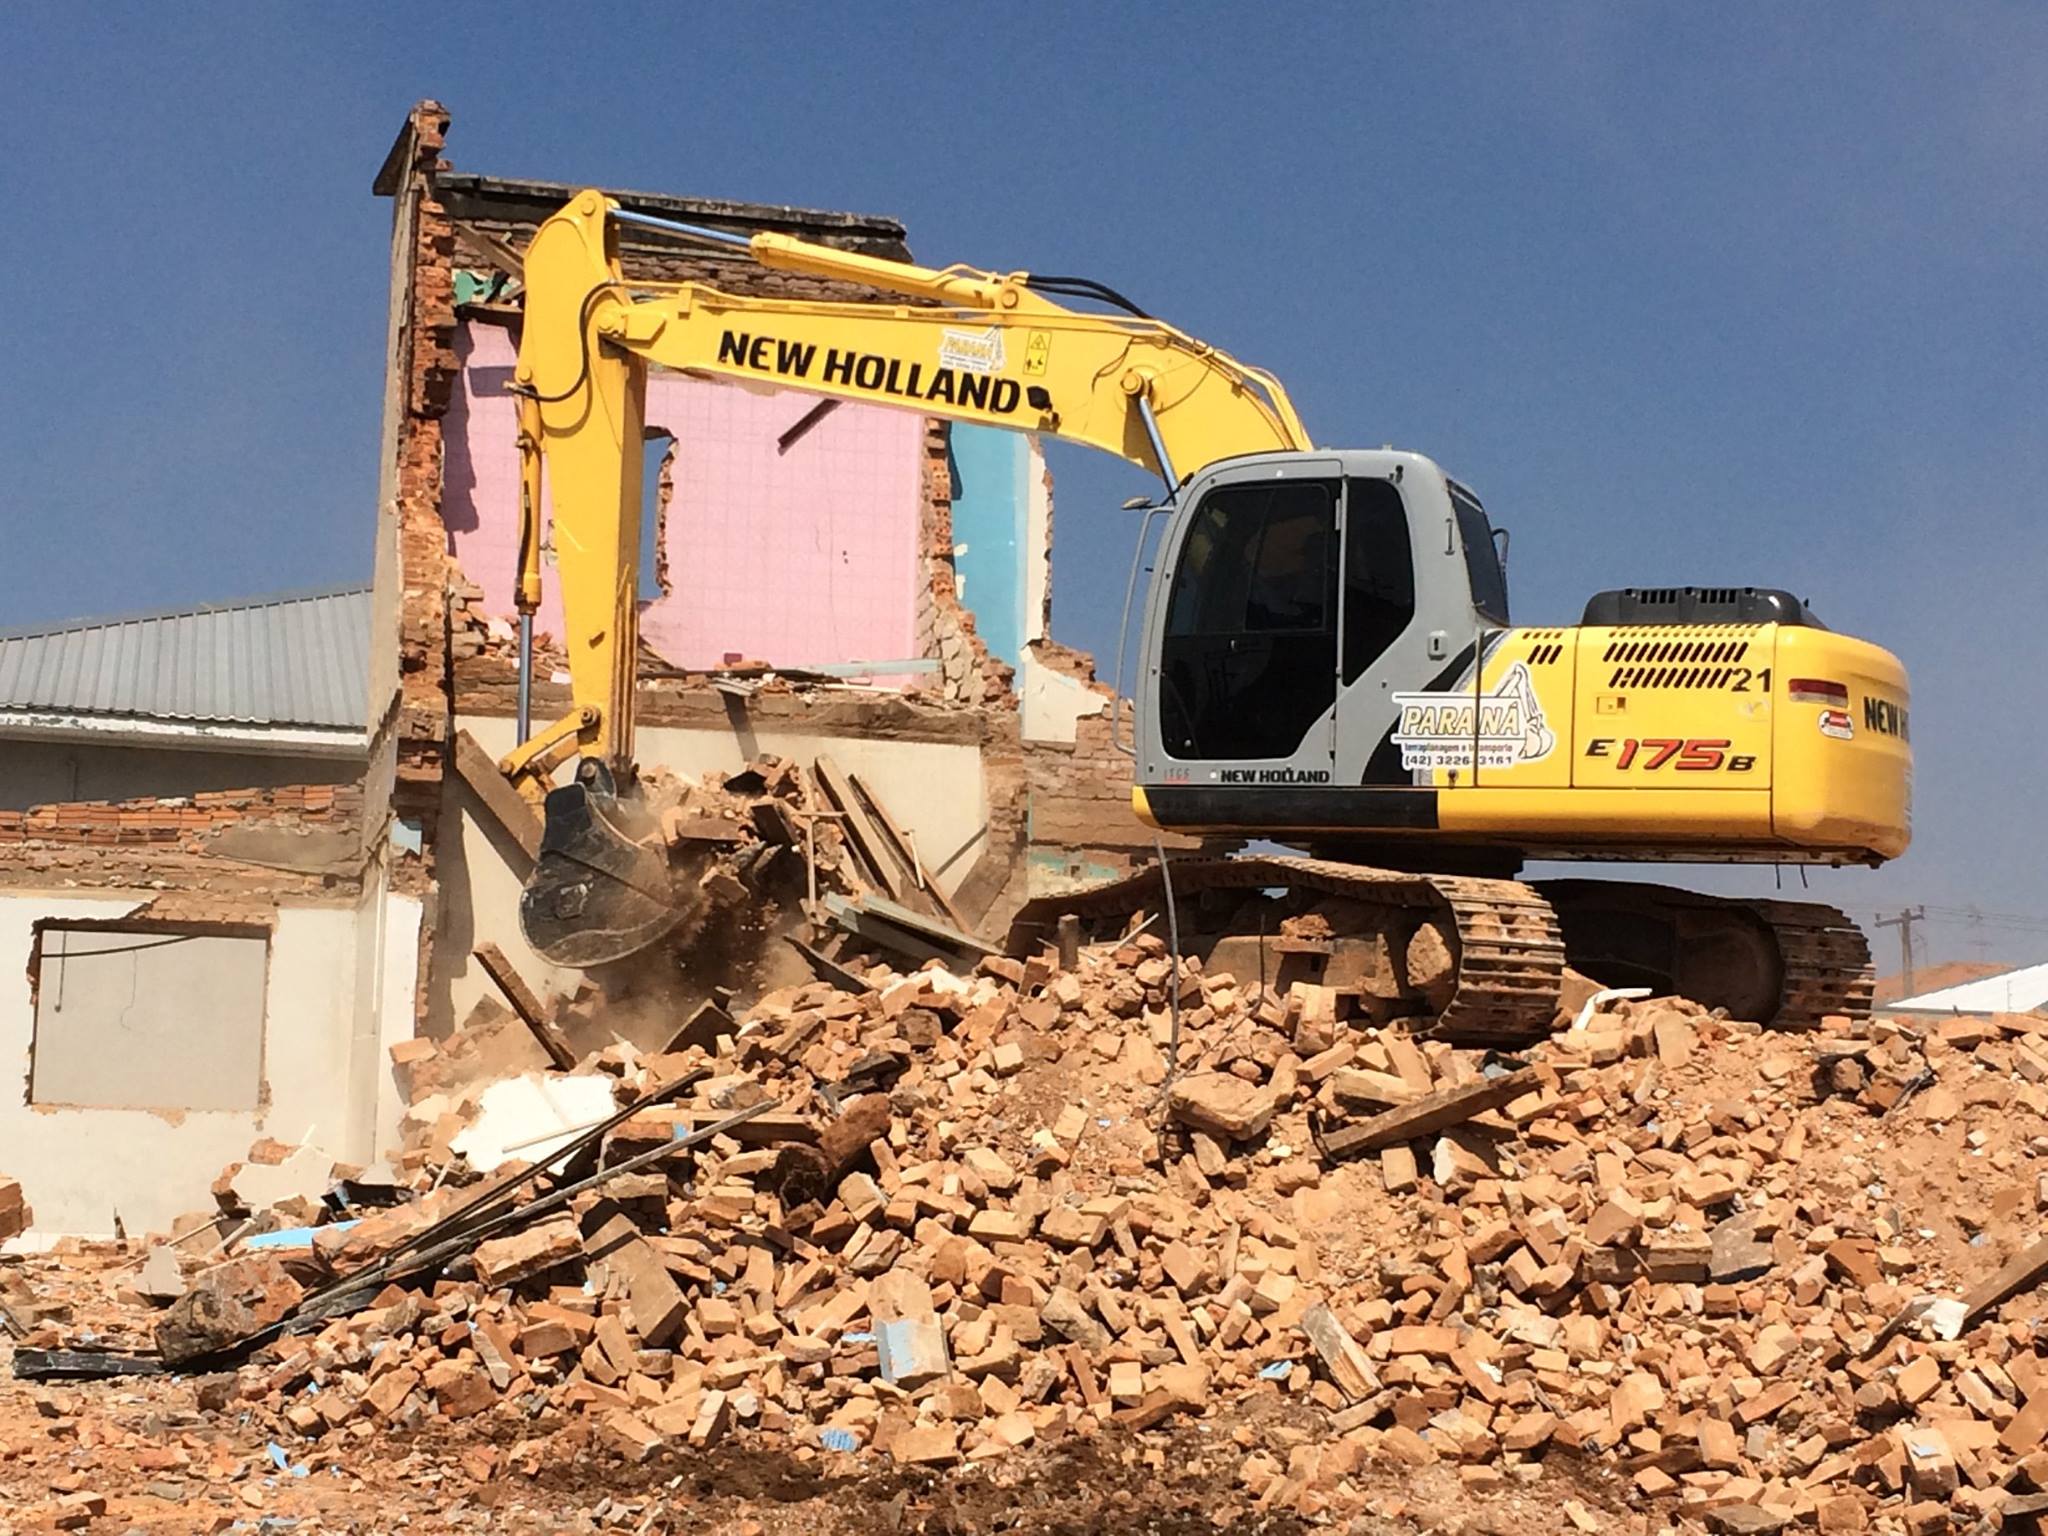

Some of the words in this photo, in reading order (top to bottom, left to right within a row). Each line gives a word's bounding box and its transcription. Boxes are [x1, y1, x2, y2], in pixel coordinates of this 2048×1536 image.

[718, 331, 817, 378] NEW
[822, 349, 1021, 414] HOLLAND
[1731, 668, 1771, 693] 21
[1401, 701, 1520, 736] PARANÁ
[1863, 696, 1899, 736] NEW
[1220, 769, 1257, 783] NEW
[1258, 768, 1331, 783] HOLLAND
[1405, 755, 1432, 766] (42)
